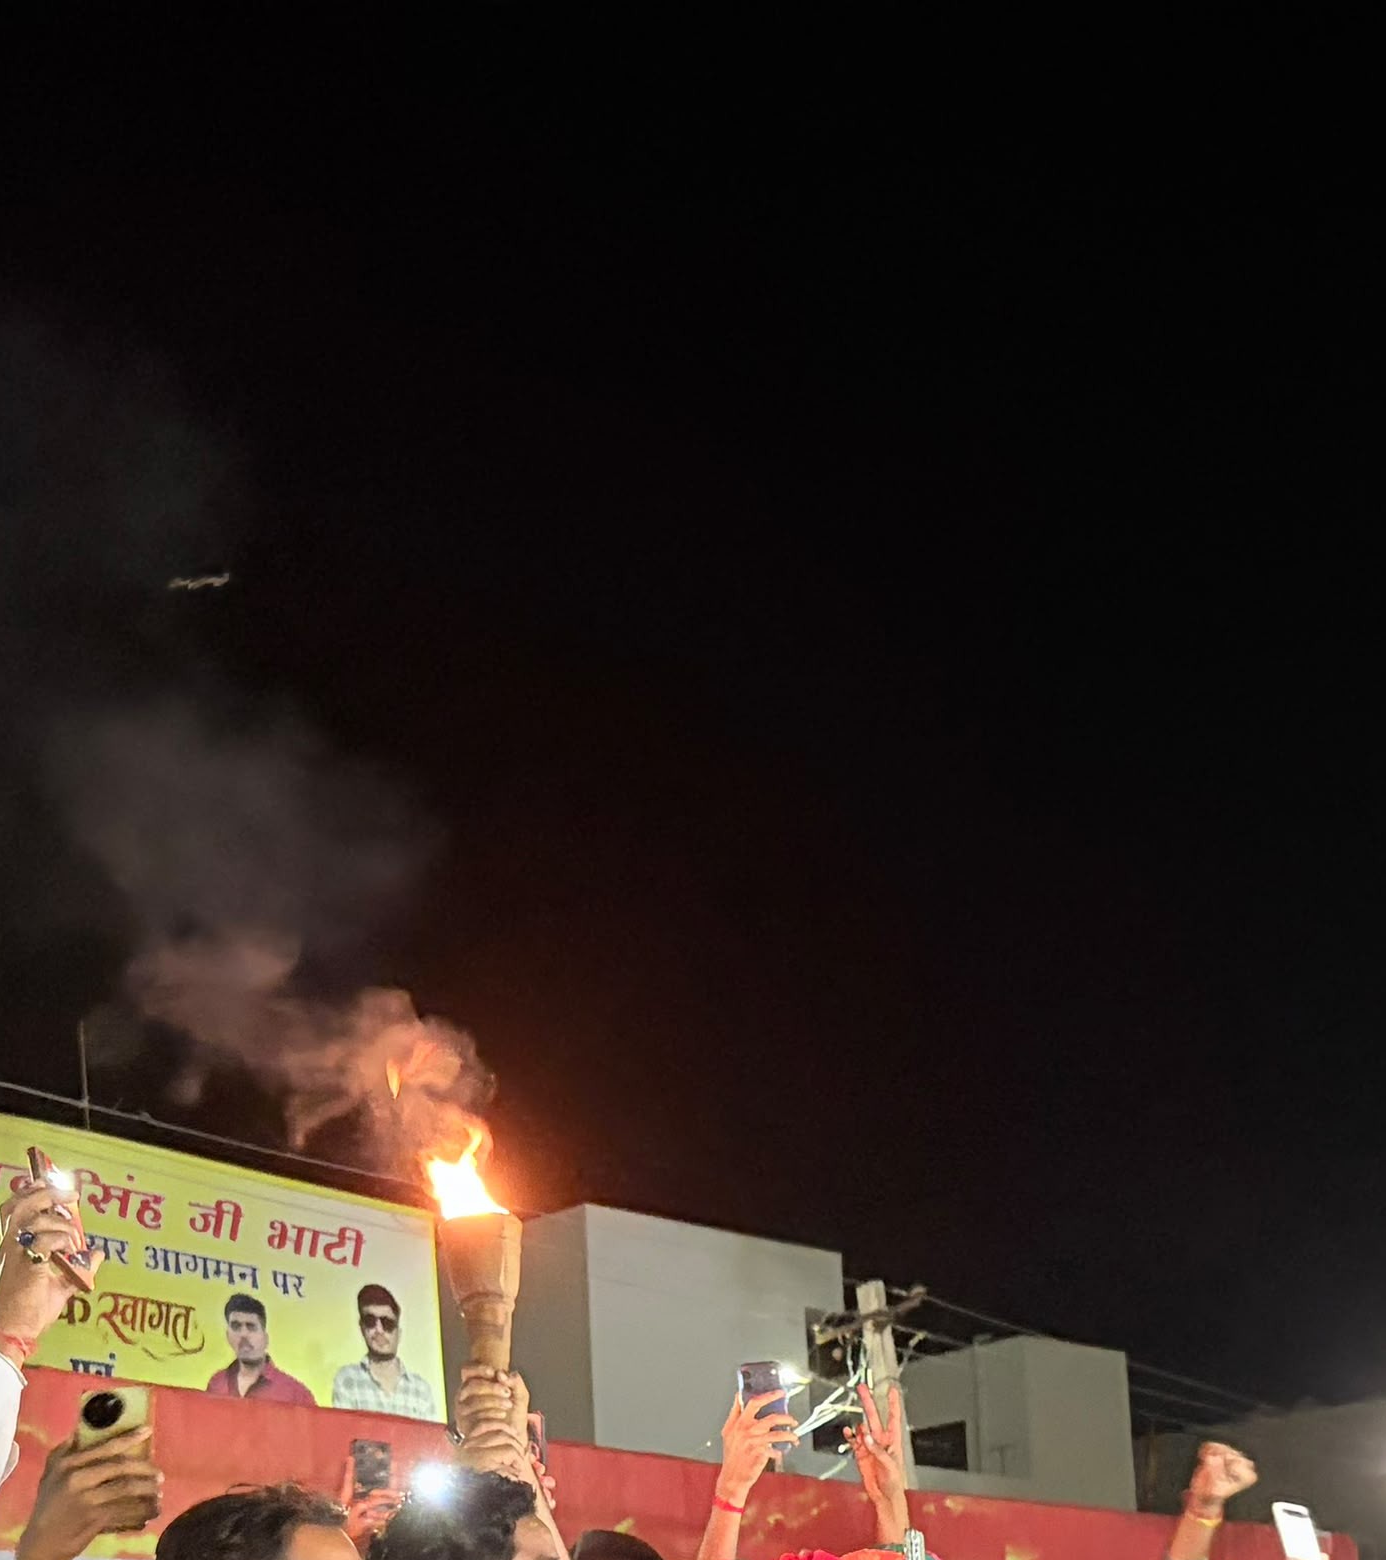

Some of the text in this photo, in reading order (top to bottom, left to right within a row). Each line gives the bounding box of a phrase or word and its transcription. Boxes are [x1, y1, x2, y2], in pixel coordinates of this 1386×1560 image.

[75, 1168, 164, 1230] सिंह
[188, 1200, 245, 1242] जी
[267, 1219, 365, 1267] भाटी
[145, 1245, 259, 1290] आगमन
[273, 1269, 306, 1298] पर
[96, 1291, 205, 1360] स्वागत
